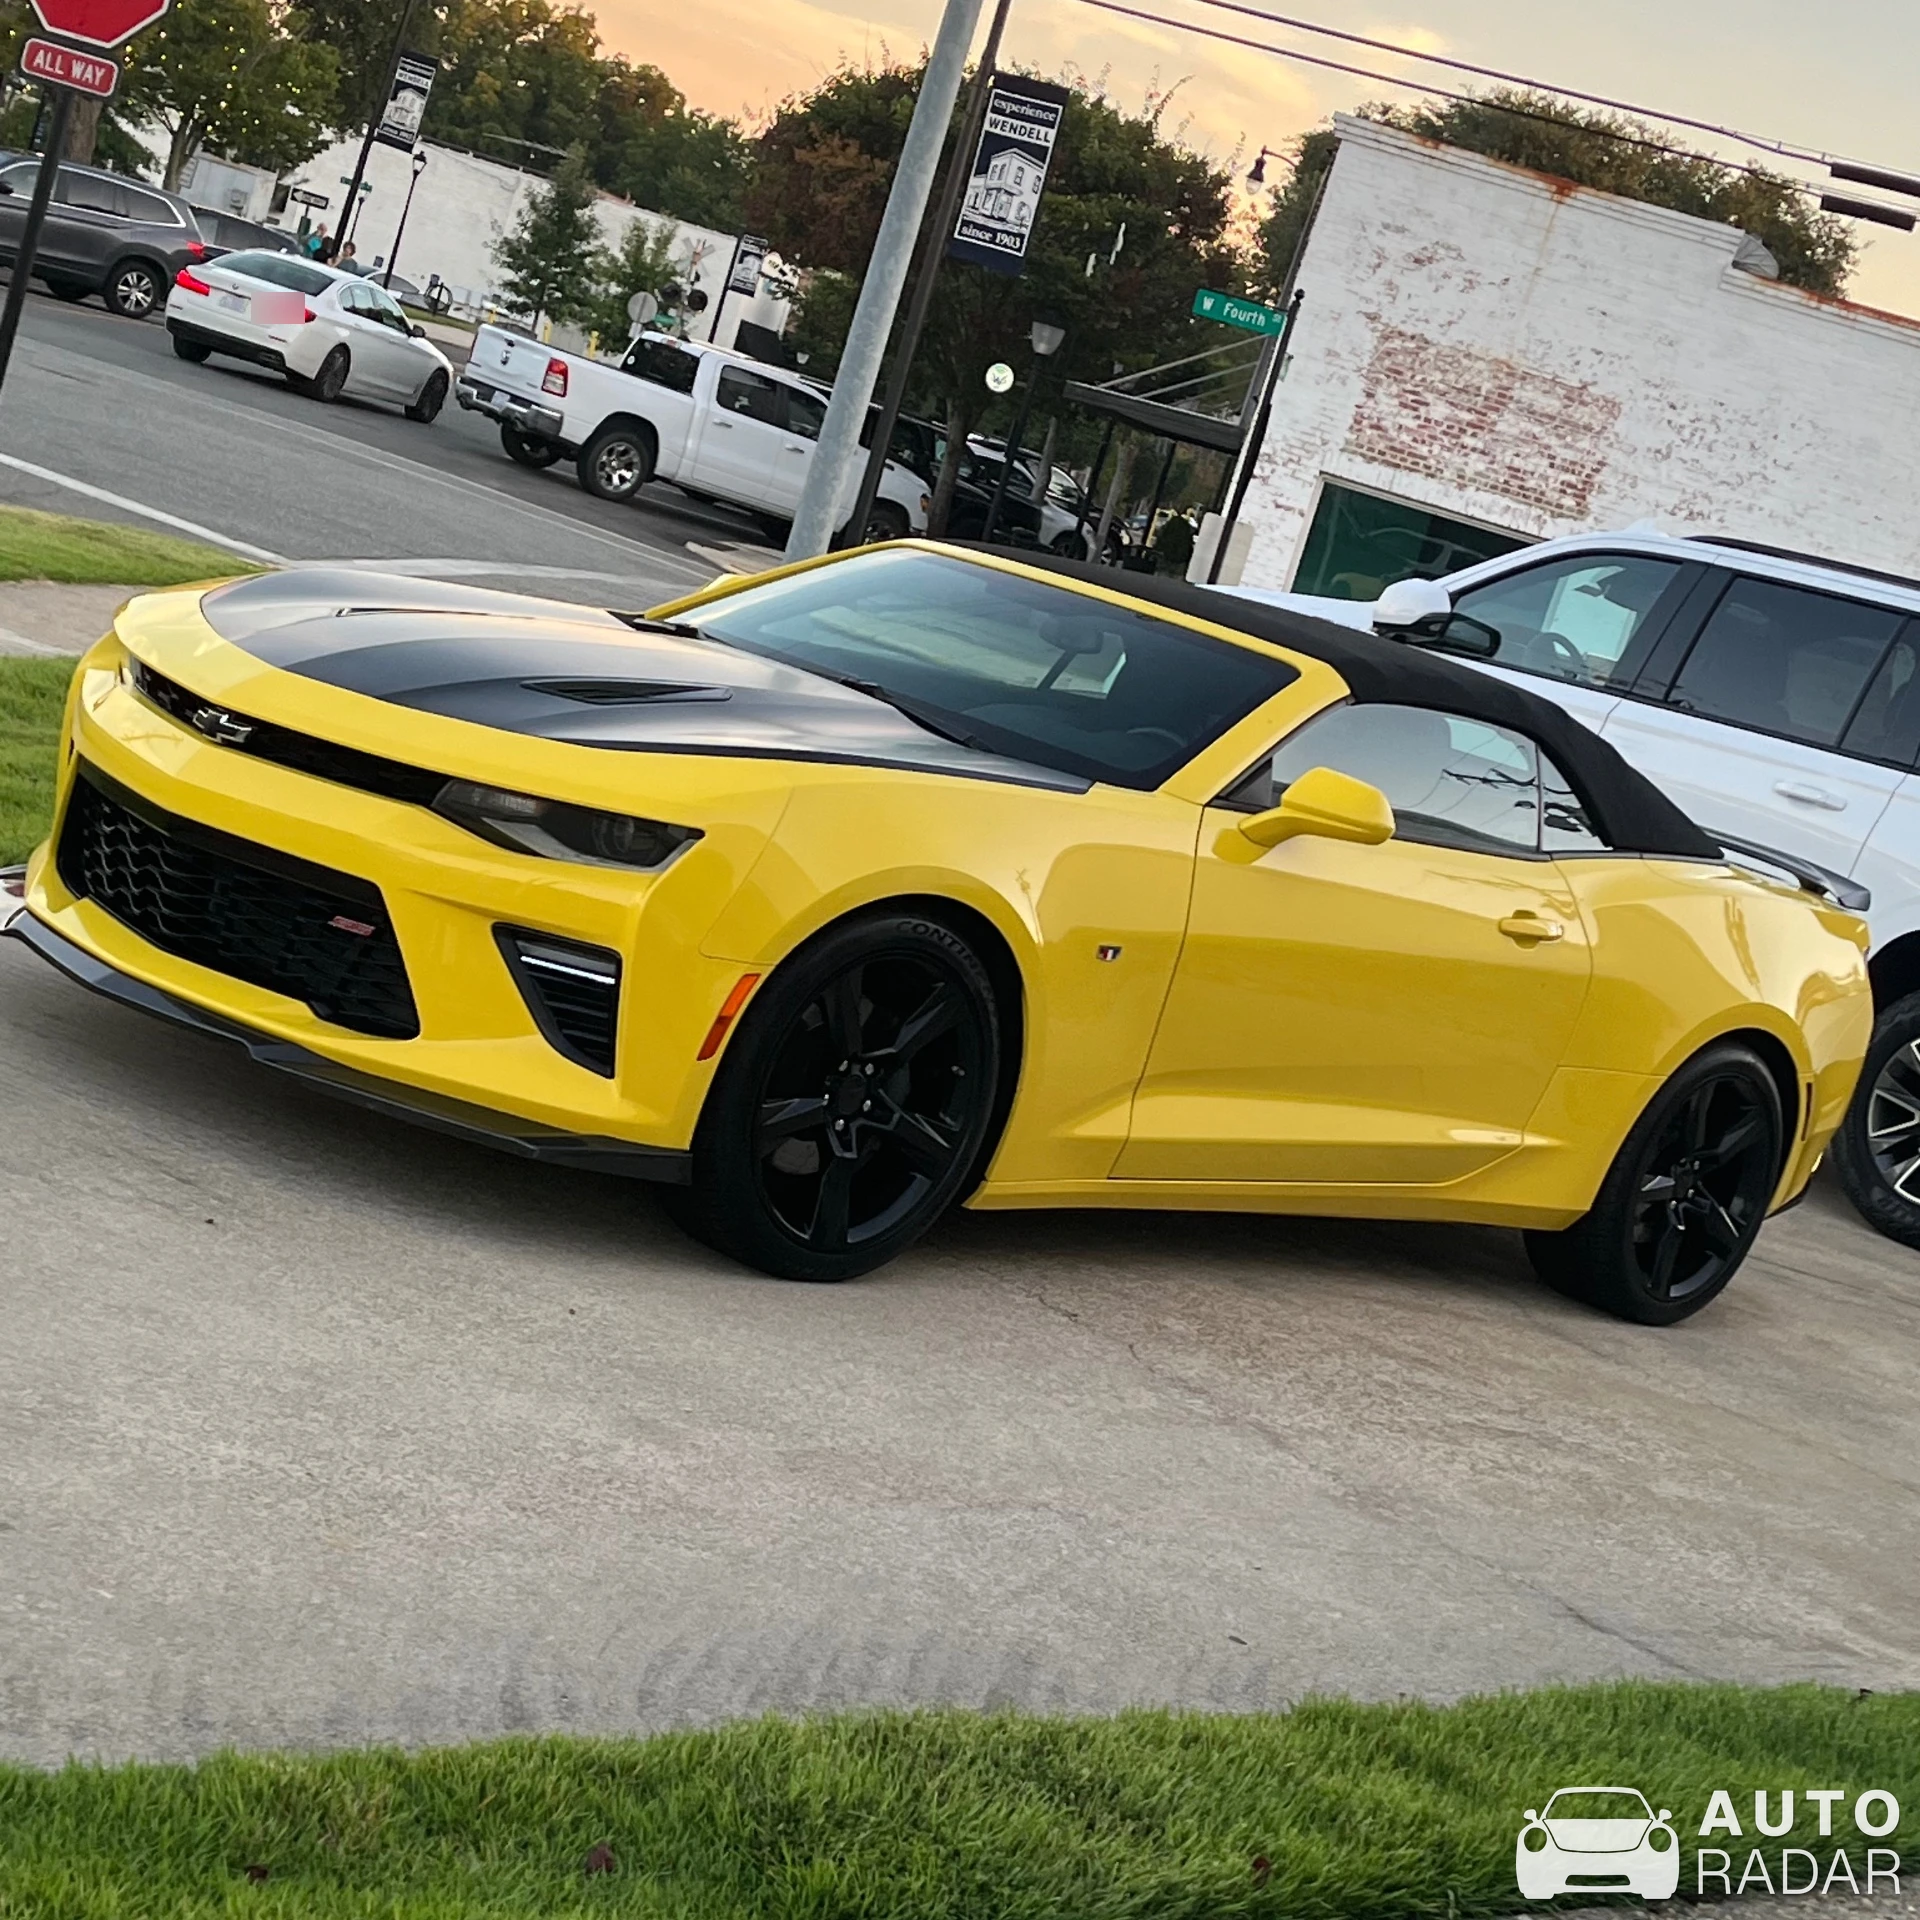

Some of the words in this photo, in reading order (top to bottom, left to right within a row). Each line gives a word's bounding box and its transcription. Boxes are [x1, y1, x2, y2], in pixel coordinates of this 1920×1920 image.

[33, 49, 64, 75] ALL
[72, 59, 106, 87] WAY
[993, 98, 1057, 122] experience
[989, 116, 1051, 143] WENDELL
[961, 224, 993, 241] since
[995, 232, 1021, 249] 1903
[1202, 296, 1215, 311] W
[1223, 302, 1266, 327] Fourth
